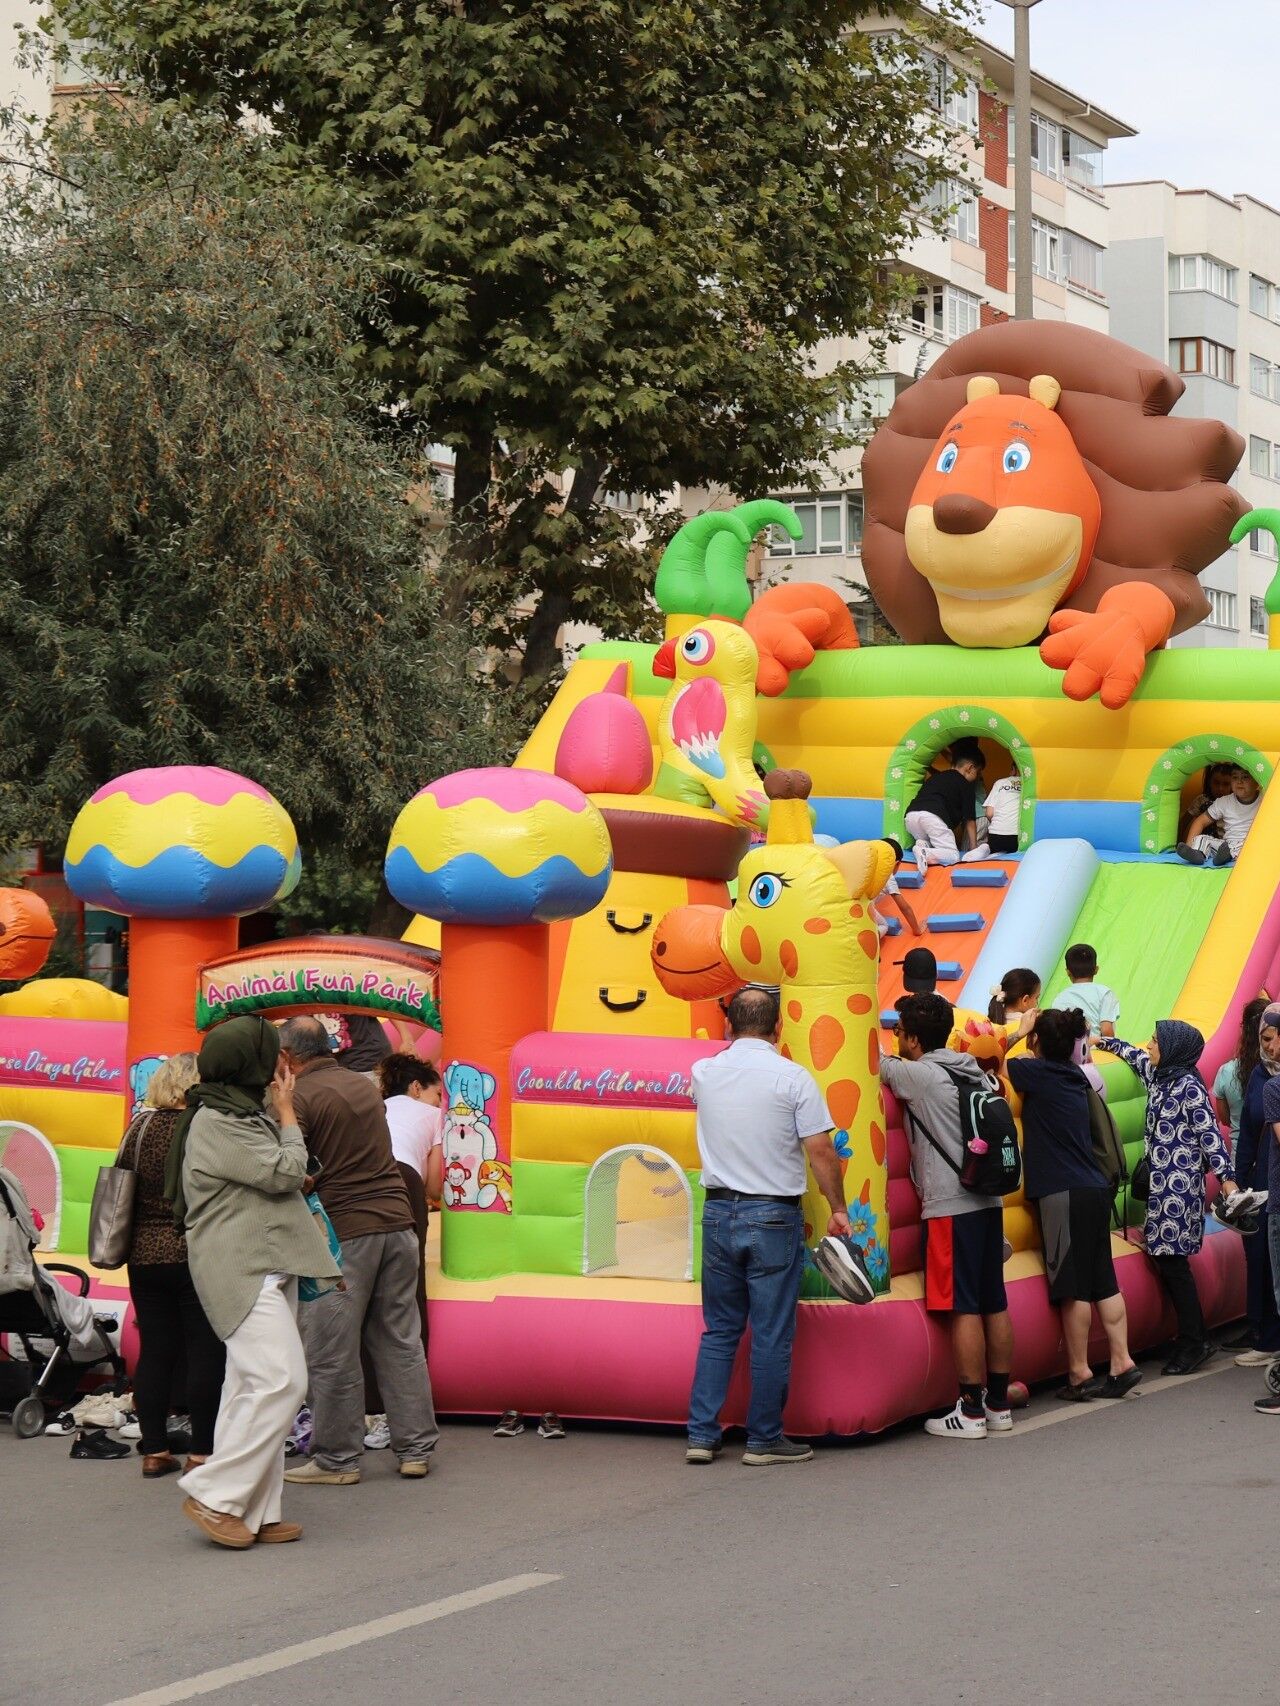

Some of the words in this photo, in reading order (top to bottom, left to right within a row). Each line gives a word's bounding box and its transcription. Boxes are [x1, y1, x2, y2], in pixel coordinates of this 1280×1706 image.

[207, 969, 297, 1008] Animal
[303, 967, 355, 992] Fun
[362, 973, 425, 1009] Park
[24, 1050, 71, 1081] Dünya
[72, 1057, 120, 1082] Güler
[517, 1068, 592, 1093] Çocuklar
[596, 1069, 662, 1096] Gülerse
[665, 1073, 698, 1104] Dün
